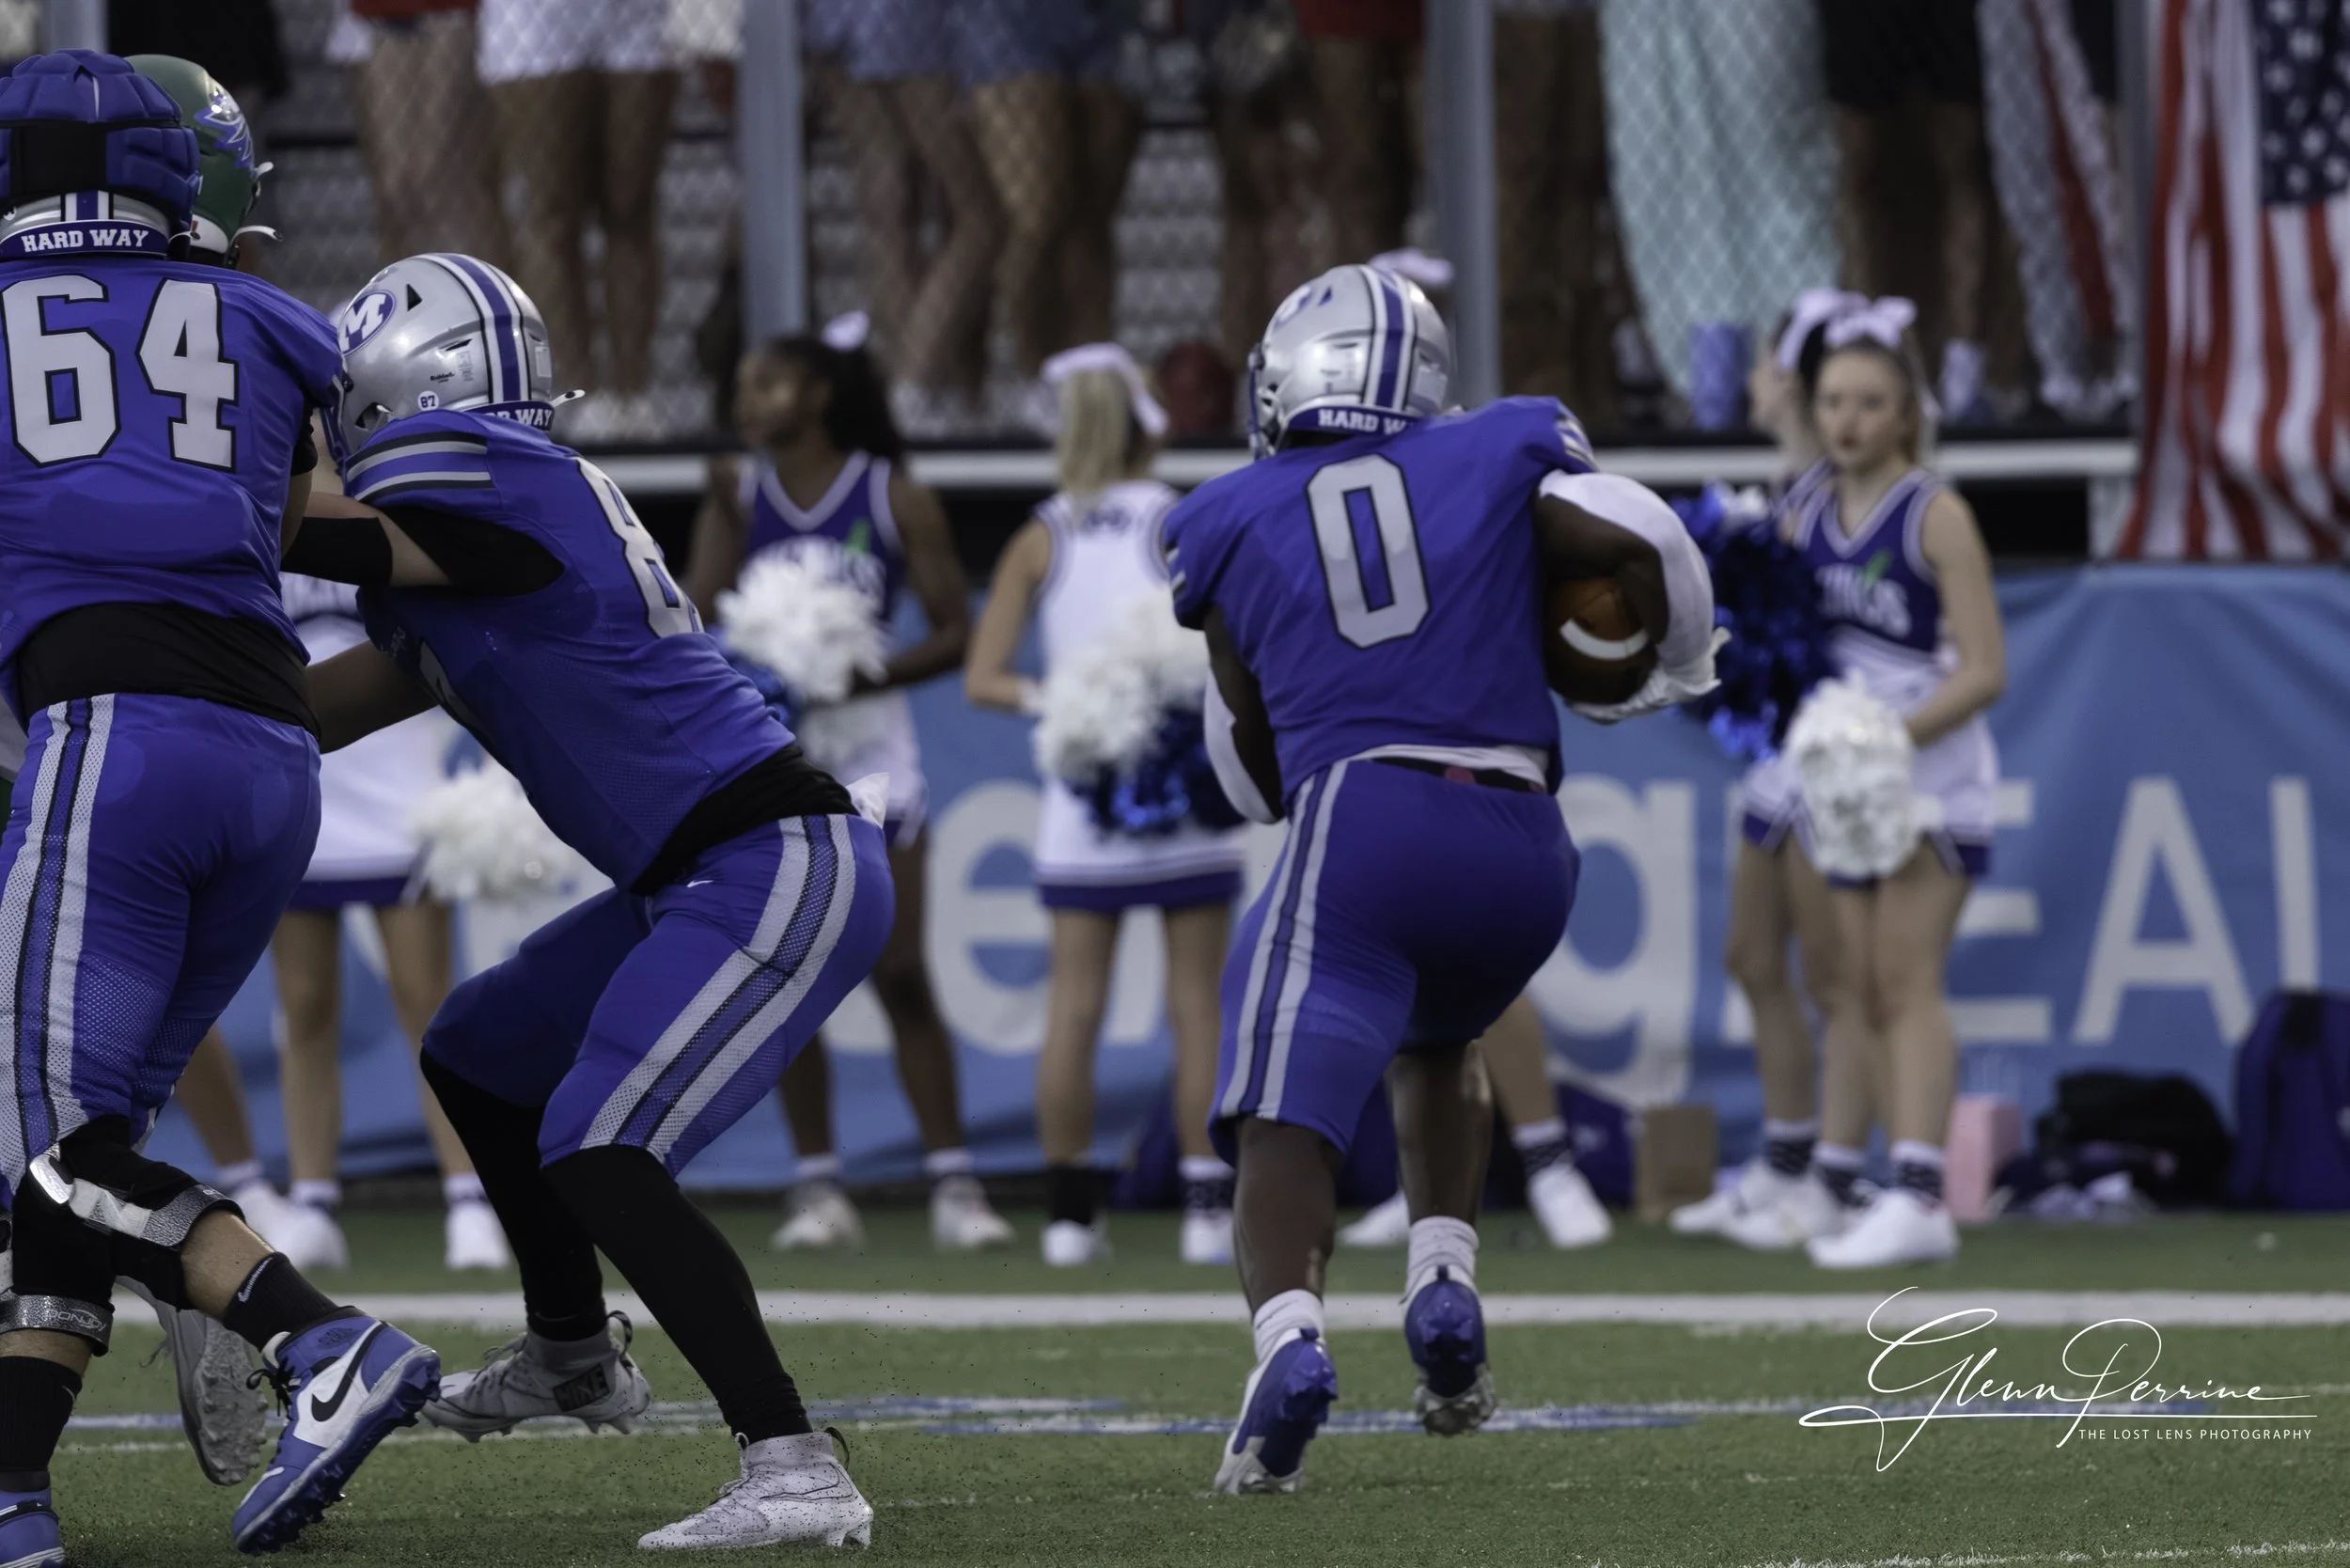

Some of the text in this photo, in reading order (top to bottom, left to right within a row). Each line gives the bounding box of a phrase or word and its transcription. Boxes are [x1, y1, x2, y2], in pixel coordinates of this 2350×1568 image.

[21, 228, 149, 253] HARD WAY
[338, 292, 386, 353] M
[0, 273, 239, 473] 64
[420, 395, 436, 408] 87
[514, 408, 553, 427] WAY
[1318, 408, 1380, 432] HARD
[1304, 449, 1432, 651] 0
